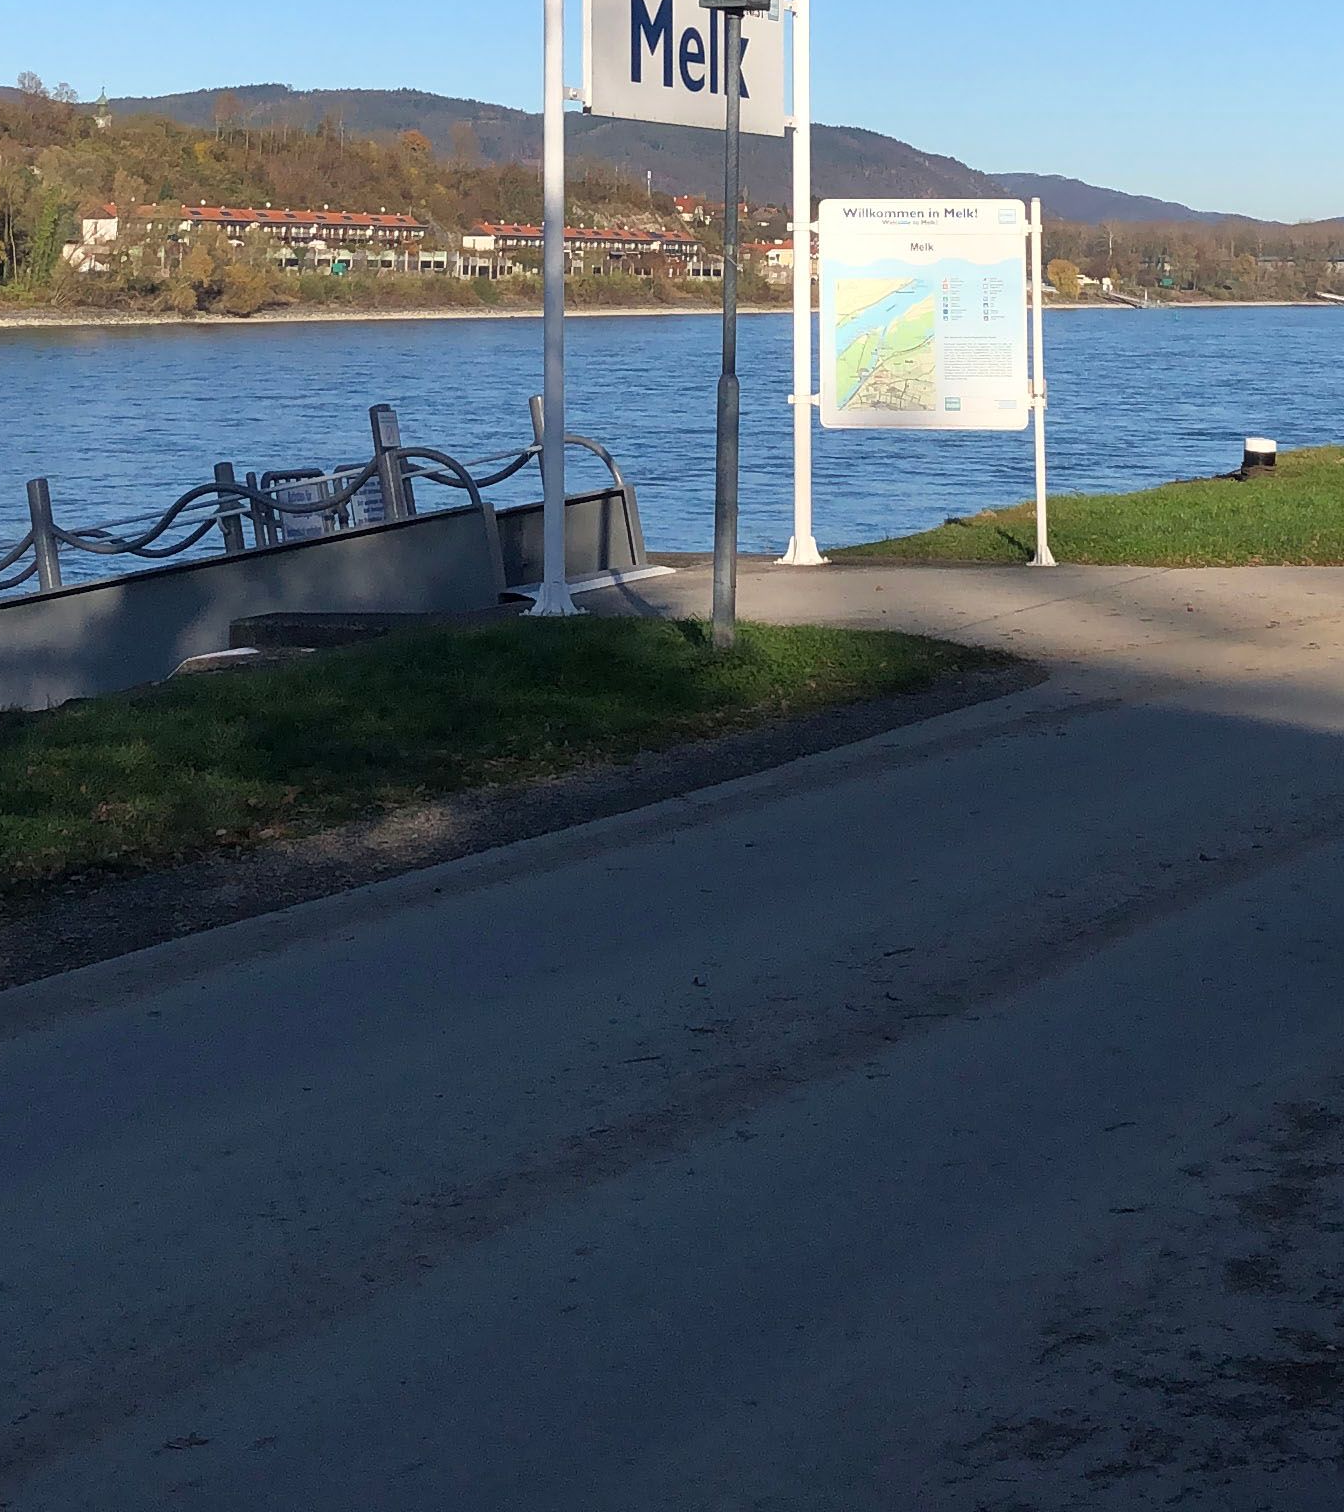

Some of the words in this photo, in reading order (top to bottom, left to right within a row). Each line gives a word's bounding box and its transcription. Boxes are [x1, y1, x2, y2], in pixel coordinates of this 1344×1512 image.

[843, 208, 925, 219] Willkommen
[928, 208, 940, 219] in
[944, 208, 979, 219] Melk!
[910, 242, 935, 252] Melk
